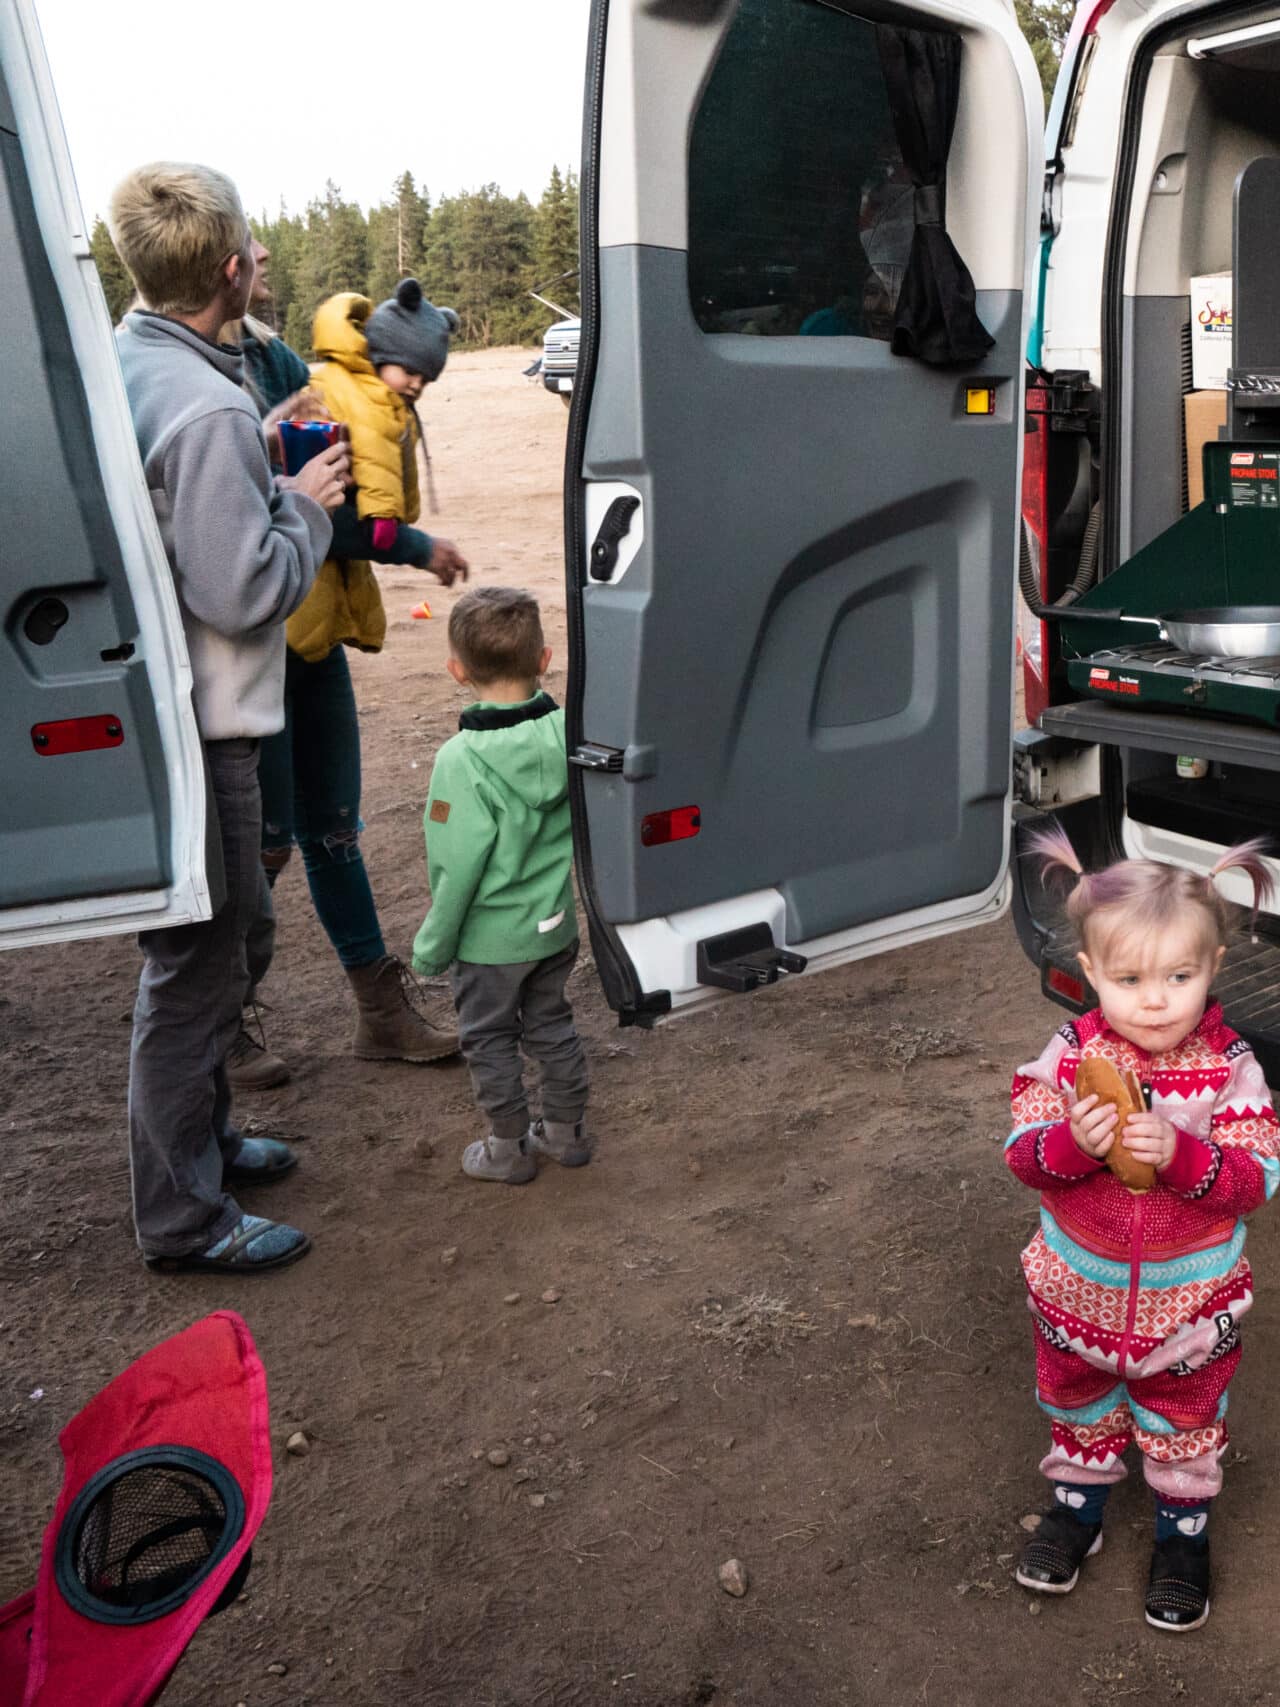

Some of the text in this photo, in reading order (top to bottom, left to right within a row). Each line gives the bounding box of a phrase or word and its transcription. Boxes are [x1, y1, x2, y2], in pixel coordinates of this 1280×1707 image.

[1230, 467, 1277, 479] PROPANE STOVE
[1090, 678, 1140, 696] PROPANE STOVE
